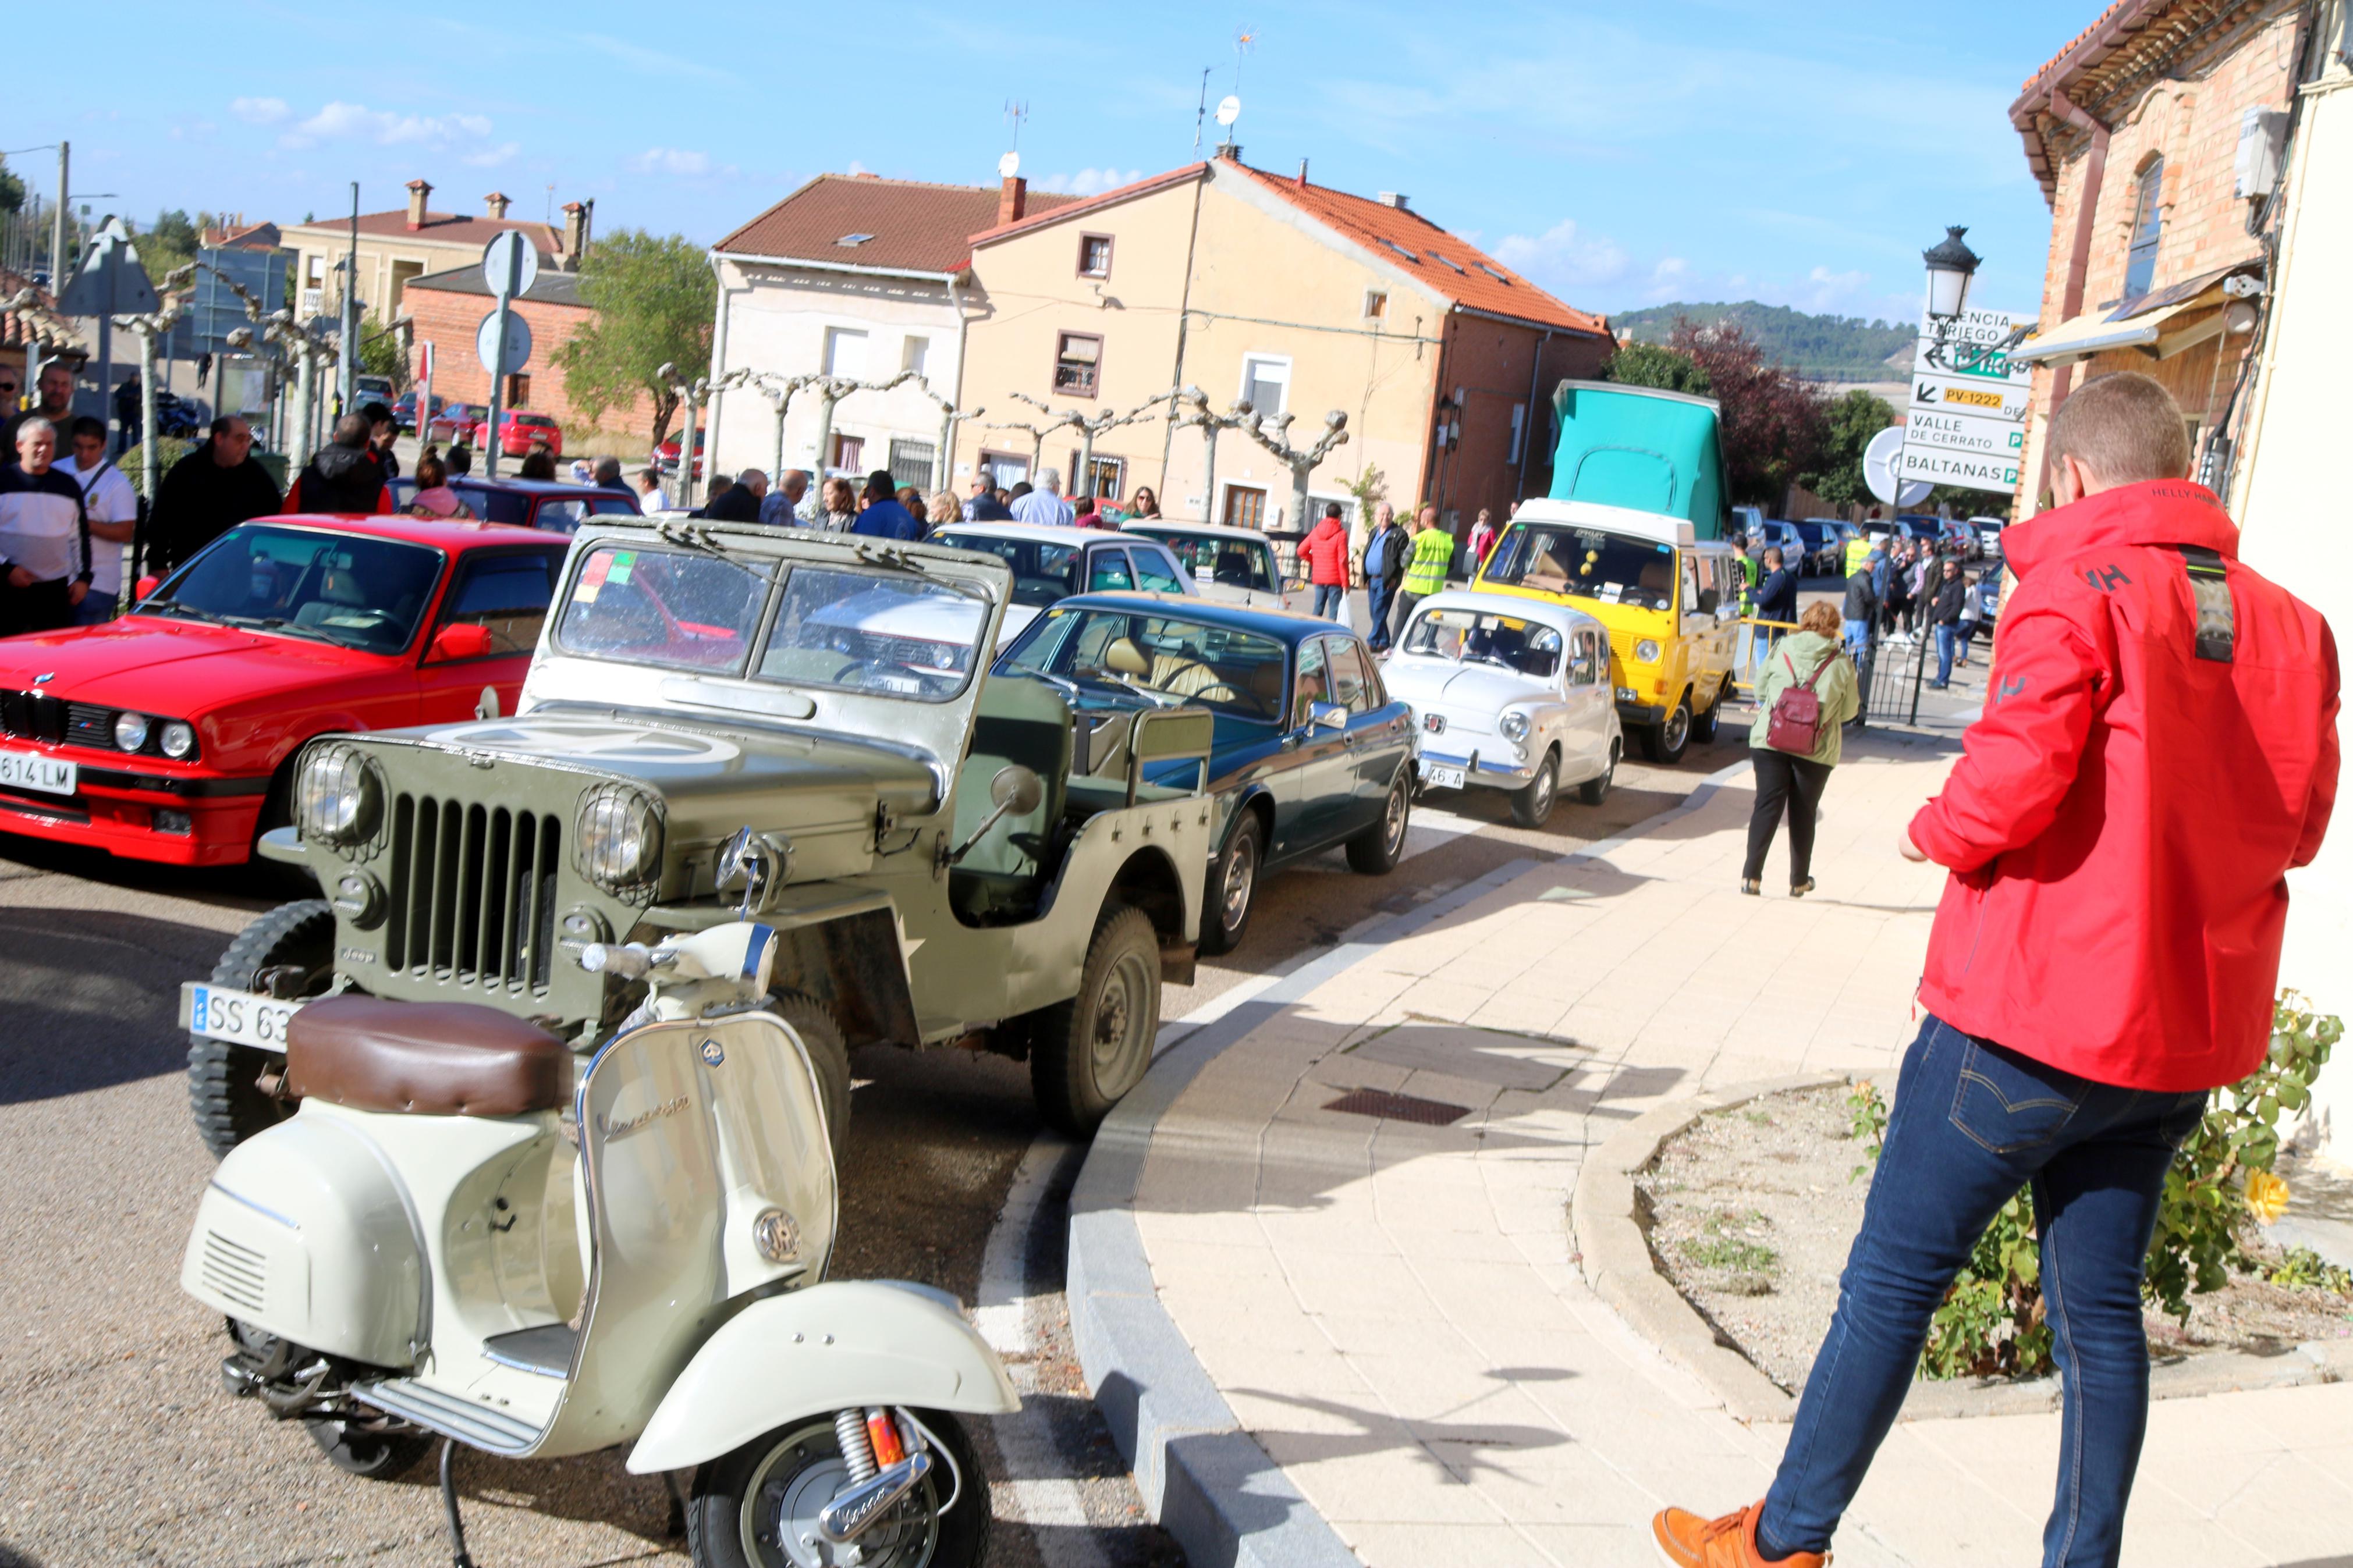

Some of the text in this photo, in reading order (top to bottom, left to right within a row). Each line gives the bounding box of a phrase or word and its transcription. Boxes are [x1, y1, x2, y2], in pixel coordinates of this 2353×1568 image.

[1946, 390, 2001, 407] PV-1222
[1914, 415, 1962, 432] VALLE
[1910, 429, 1993, 449] DE CERRATO
[1907, 455, 2001, 480] BALTANAS
[2152, 488, 2190, 499] HELLY
[210, 996, 243, 1033] SS
